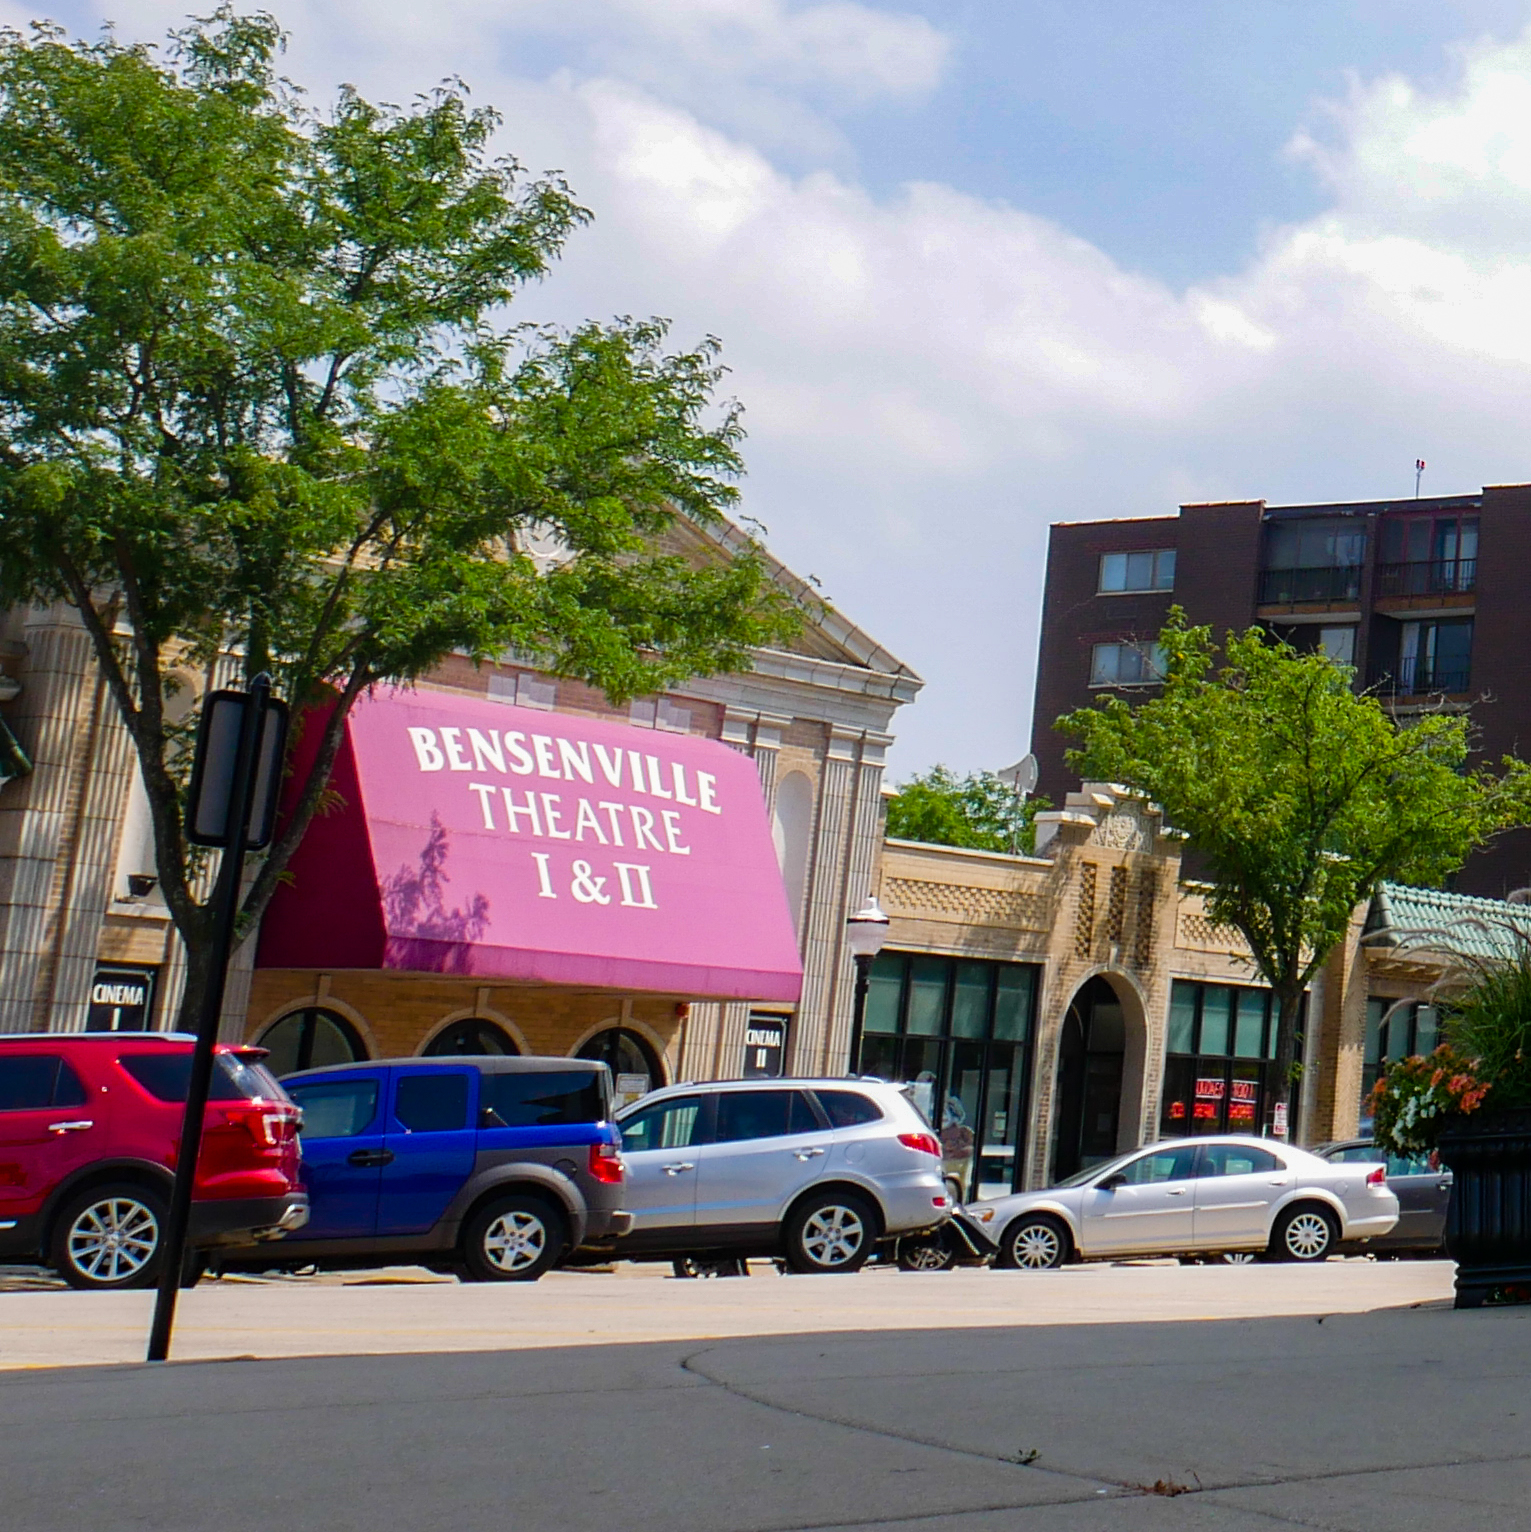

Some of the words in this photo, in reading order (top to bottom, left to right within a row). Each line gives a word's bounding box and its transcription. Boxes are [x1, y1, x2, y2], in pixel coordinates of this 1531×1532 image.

[406, 726, 722, 815] BENSENVILLE
[468, 782, 691, 855] THEATRE
[530, 851, 558, 899] I
[571, 859, 611, 906] &
[612, 862, 659, 910] II
[92, 983, 144, 1006] CINEMA
[746, 1029, 781, 1047] CINEMA
